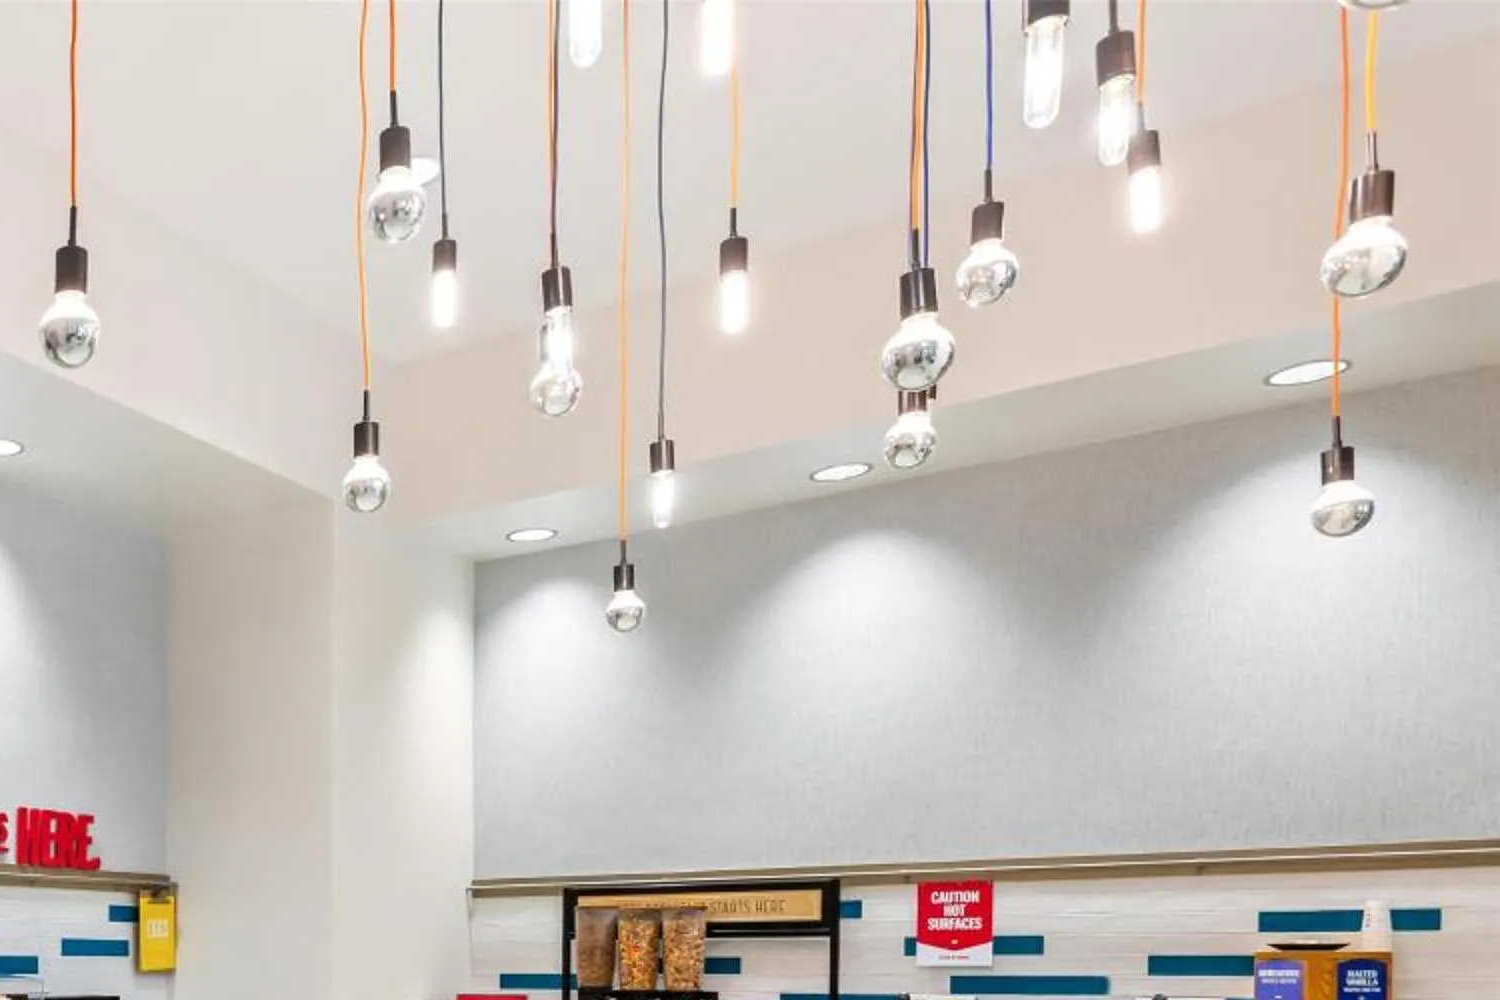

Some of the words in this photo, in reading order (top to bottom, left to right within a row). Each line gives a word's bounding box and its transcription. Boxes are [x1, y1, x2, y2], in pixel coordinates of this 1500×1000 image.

[931, 890, 980, 904] CAUTION
[708, 900, 750, 914] STARTS
[755, 899, 786, 914] HERE
[943, 904, 966, 916] HOT
[927, 917, 983, 931] SURFACES
